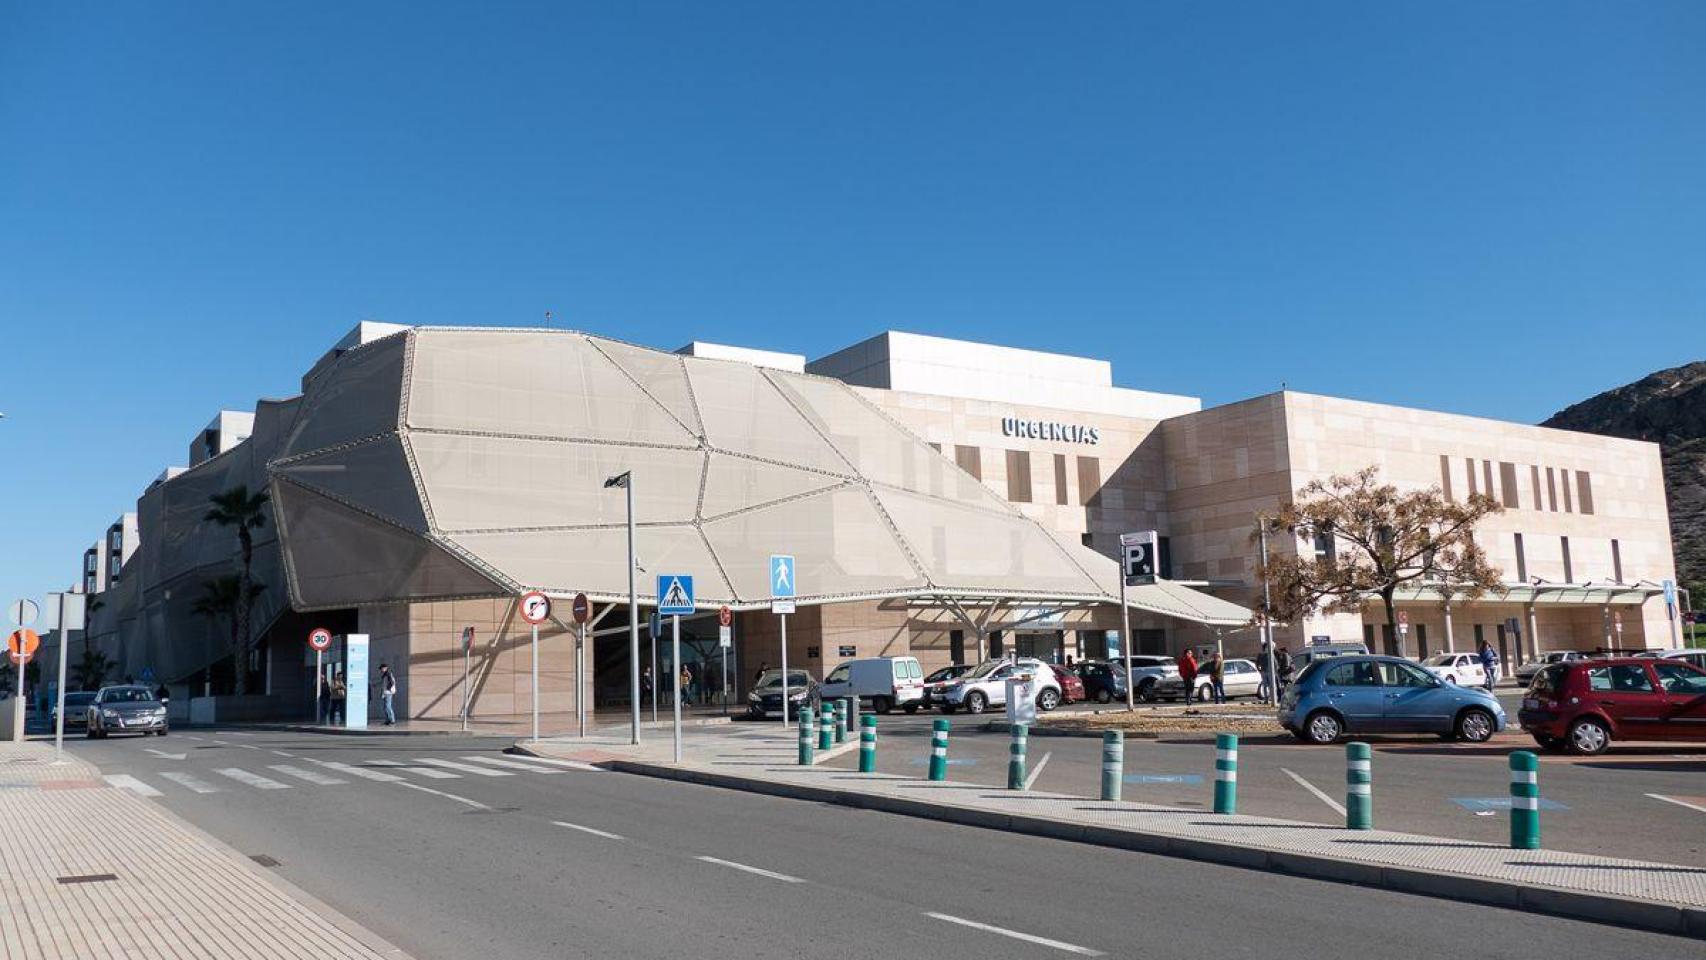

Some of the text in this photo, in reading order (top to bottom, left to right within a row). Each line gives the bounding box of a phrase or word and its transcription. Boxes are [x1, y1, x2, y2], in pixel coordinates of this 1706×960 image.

[1002, 417, 1099, 445] URGENCIAS
[1126, 545, 1145, 575] P
[314, 634, 326, 644] 30
